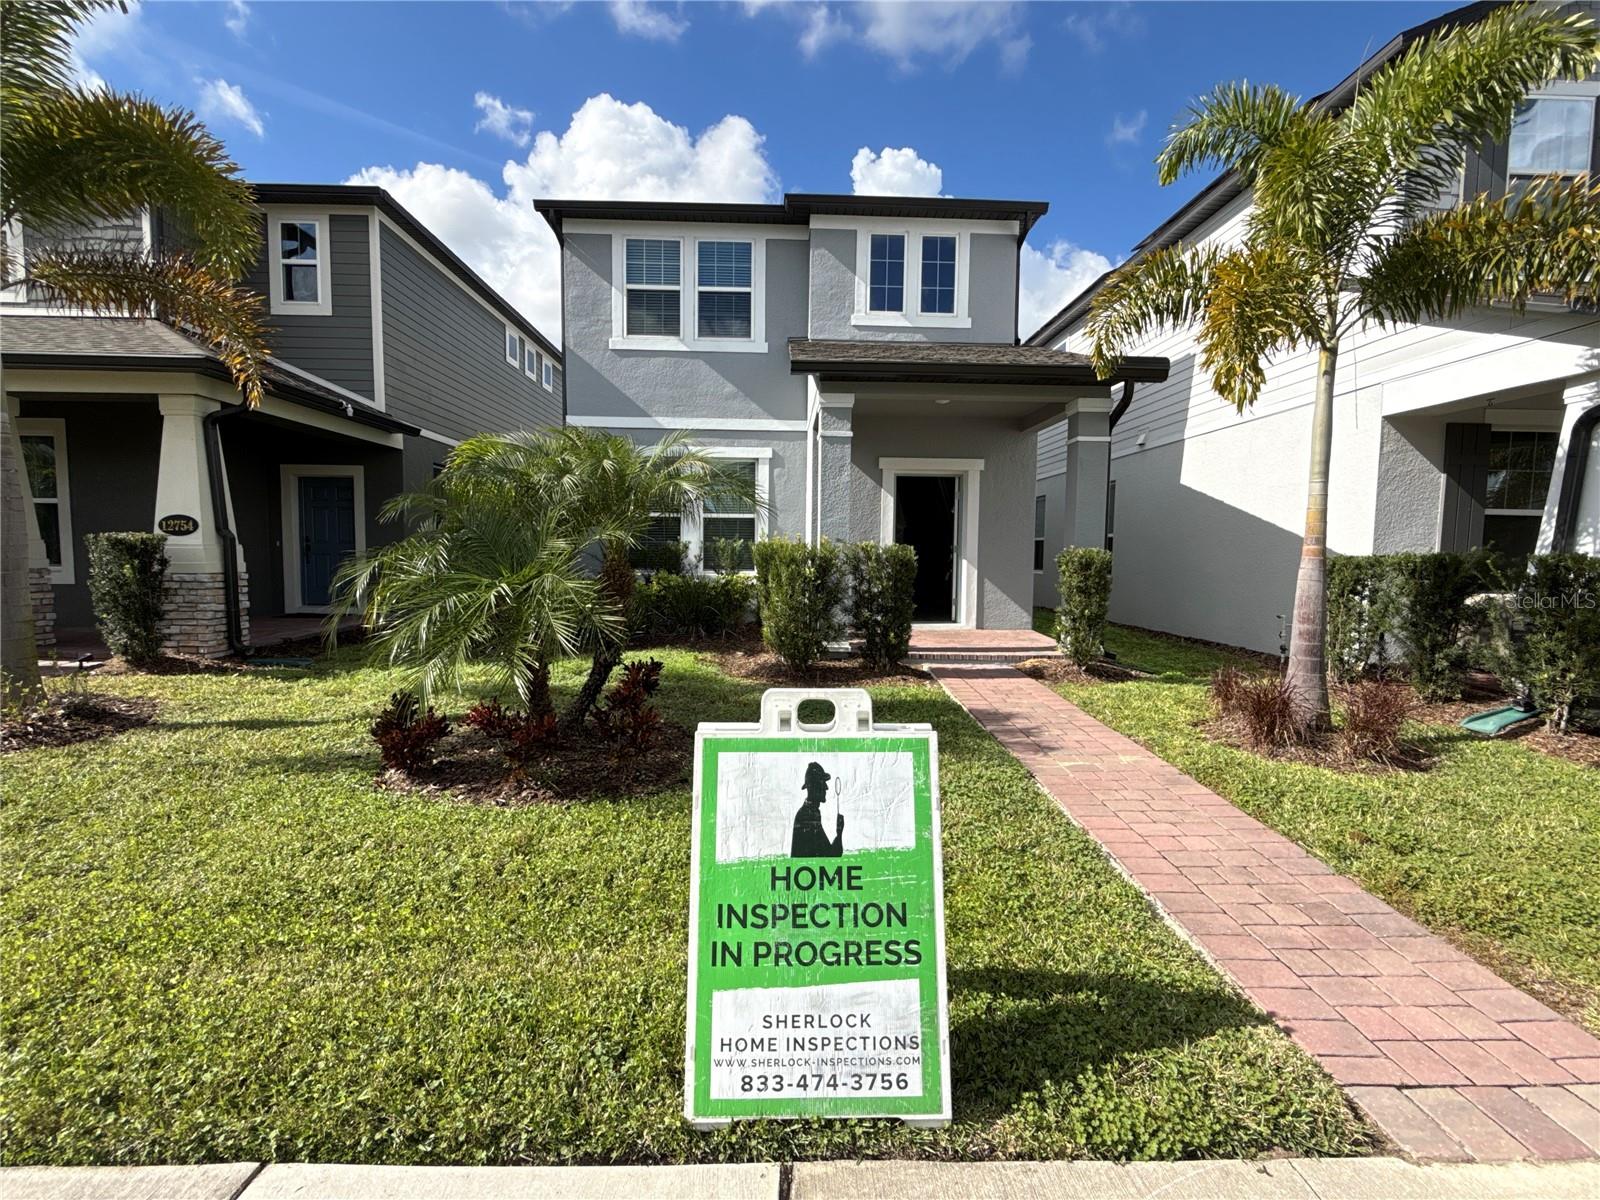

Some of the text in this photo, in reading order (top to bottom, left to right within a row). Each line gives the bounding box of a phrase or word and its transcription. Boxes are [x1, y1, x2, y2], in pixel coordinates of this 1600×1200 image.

[161, 519, 194, 531] 12754
[771, 865, 863, 891] HOME
[717, 902, 907, 929] INSPECTION
[711, 939, 922, 967] IN PROGRESS
[762, 1013, 872, 1029] SHERLOCK
[720, 1035, 920, 1052] HOME INSPECTIONS
[714, 1056, 920, 1068] WWW.SHERLOCK-INSPECTIONS.COM
[740, 1073, 909, 1092] 833-474-3756
